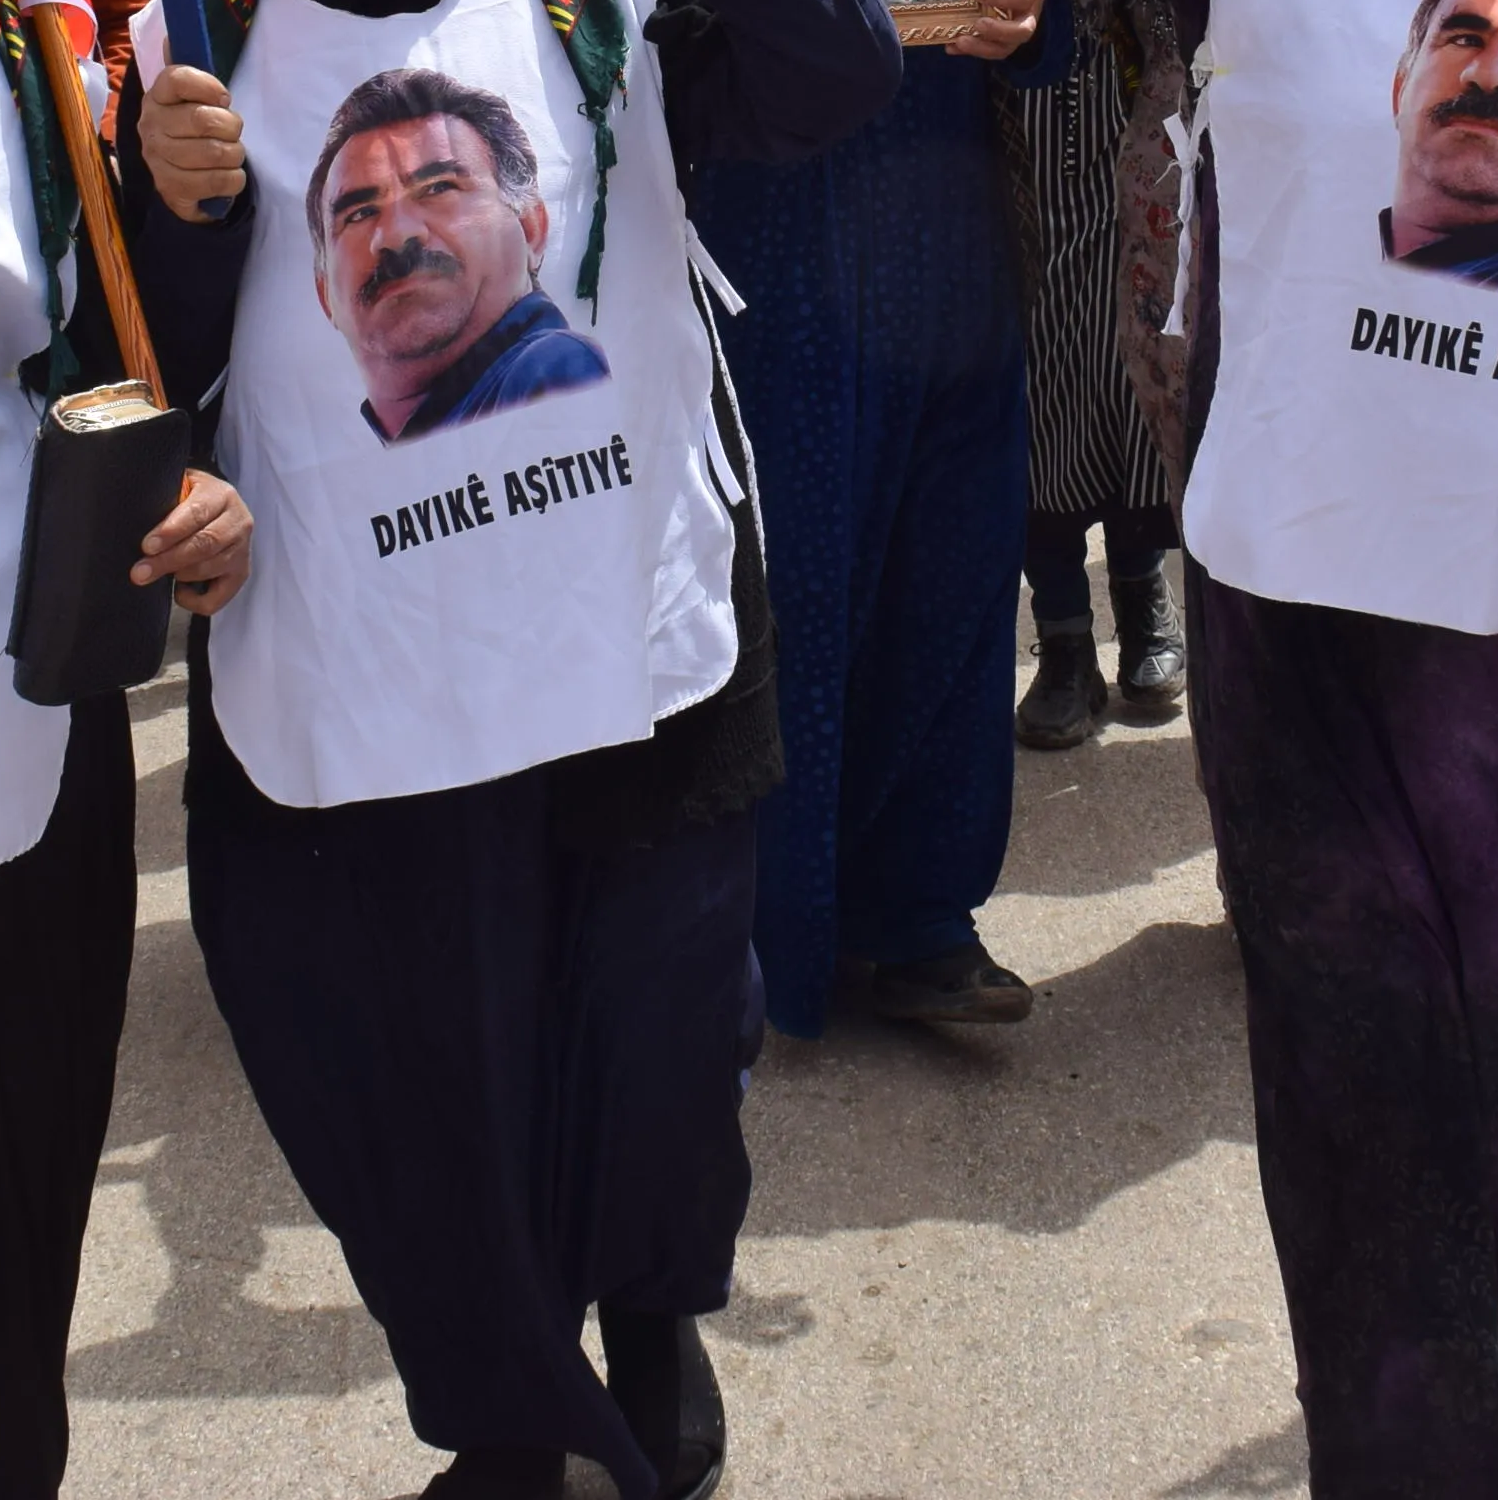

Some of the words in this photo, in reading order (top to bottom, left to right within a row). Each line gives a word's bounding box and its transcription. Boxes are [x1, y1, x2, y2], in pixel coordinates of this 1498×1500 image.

[1350, 307, 1485, 376] DAYIKÊ
[369, 472, 496, 559] DAYIKÊ
[502, 433, 634, 516] AŞÎTIYÊ
